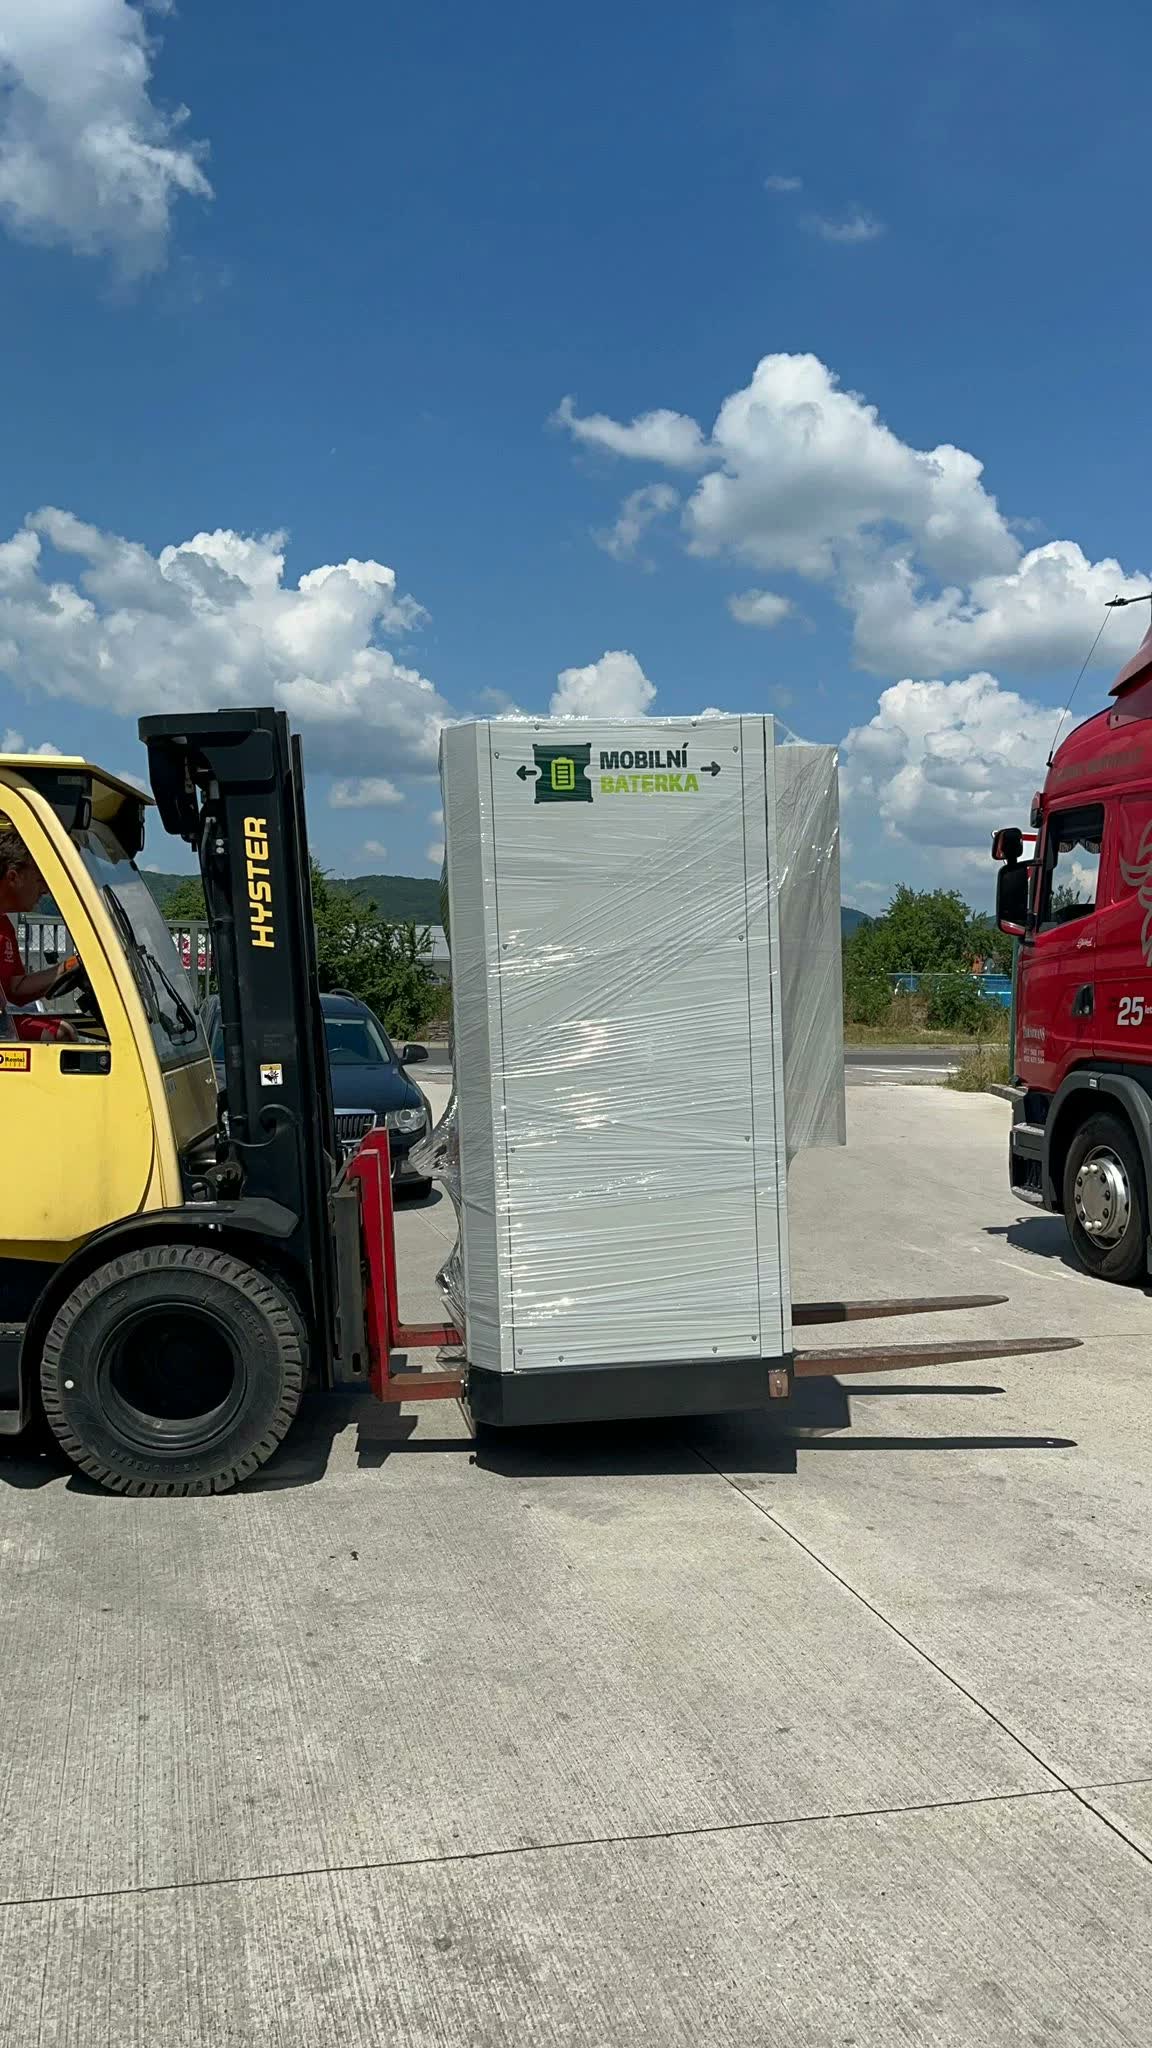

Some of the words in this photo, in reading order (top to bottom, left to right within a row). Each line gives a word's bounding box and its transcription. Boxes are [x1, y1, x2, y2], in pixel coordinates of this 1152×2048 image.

[600, 743, 689, 769] MOBILNÍ
[600, 773, 699, 793] BATERKA
[243, 816, 275, 948] HYSTER
[1116, 996, 1145, 1026] 25
